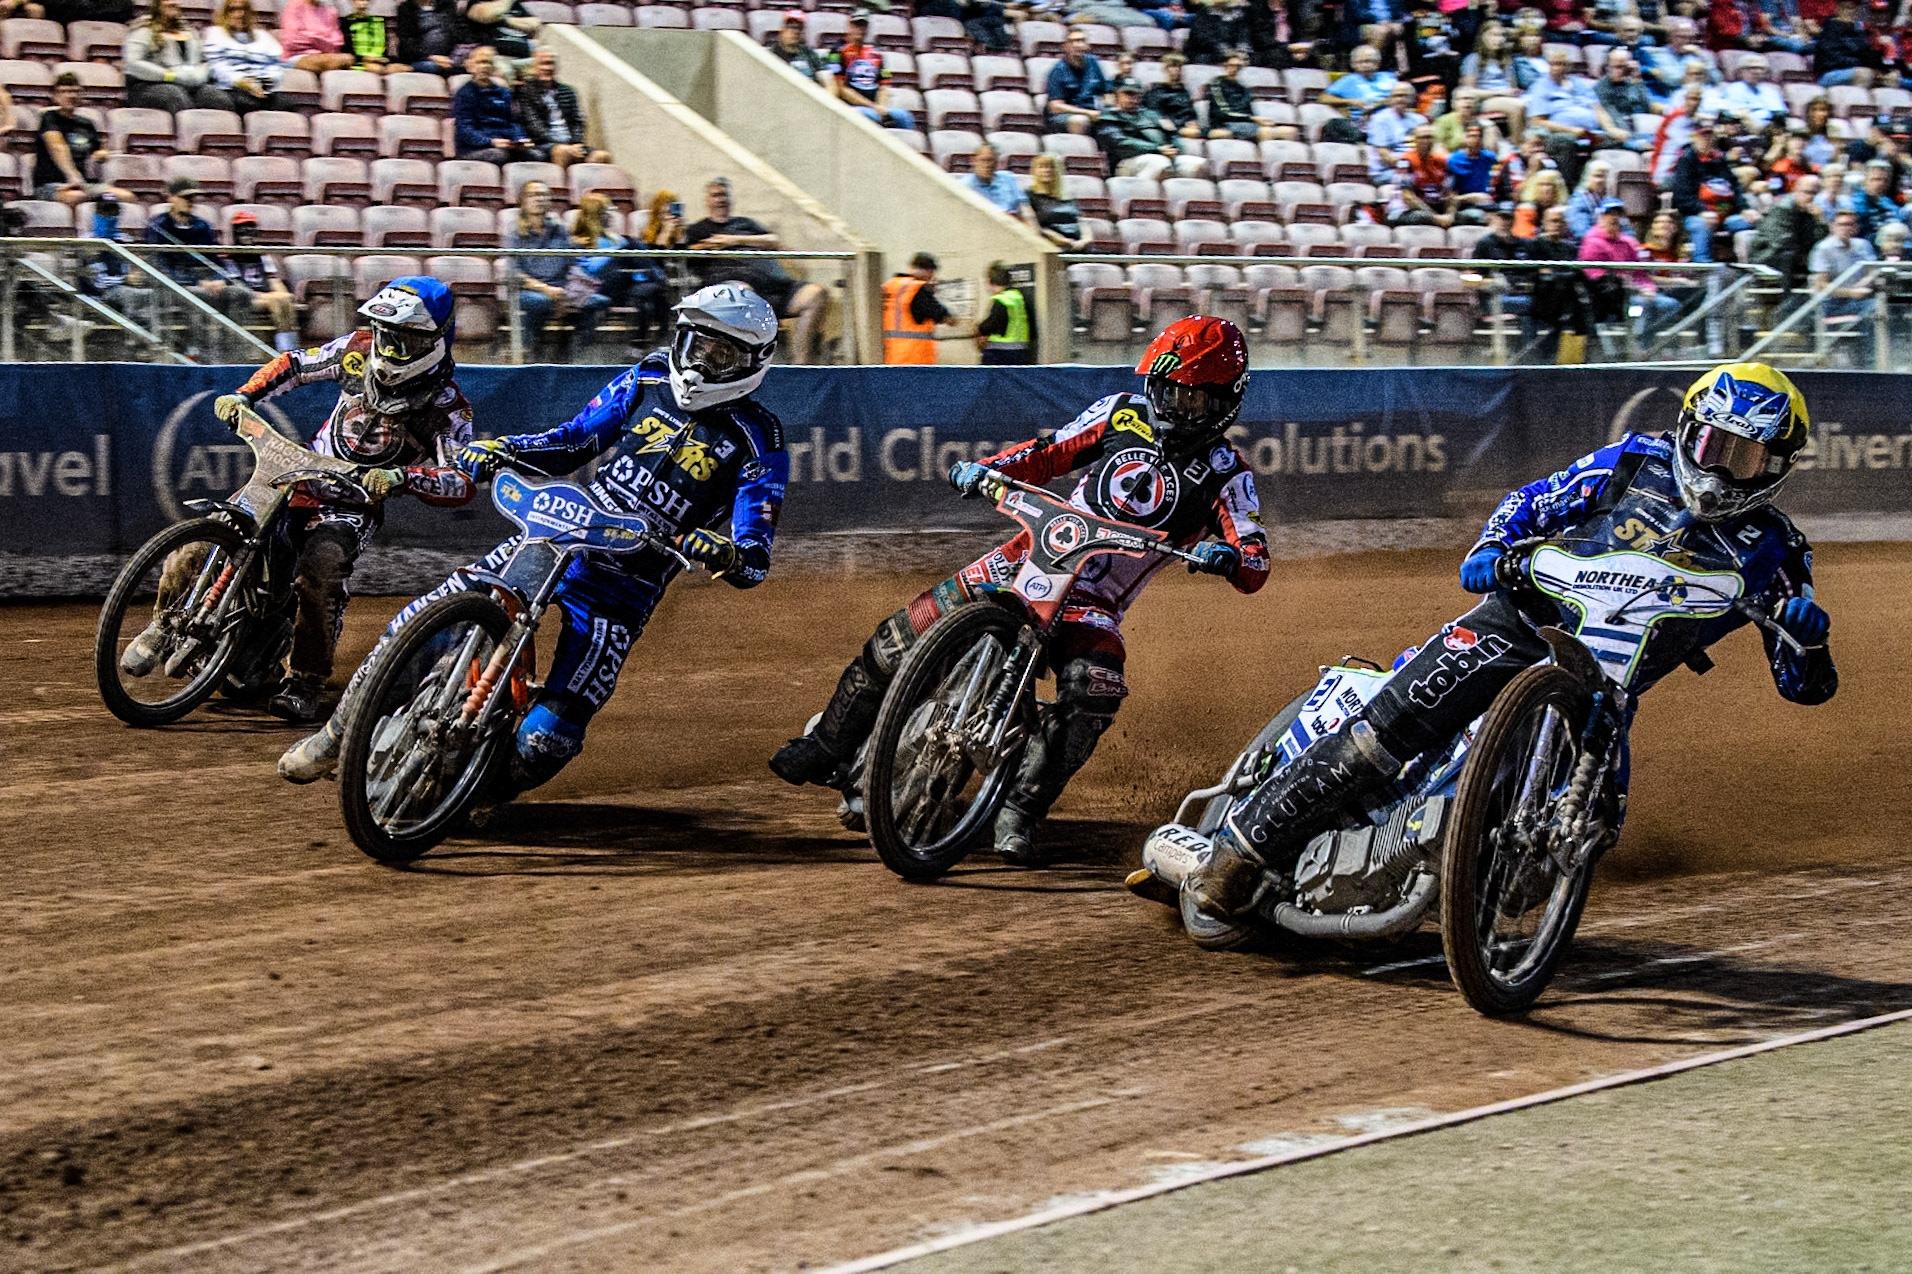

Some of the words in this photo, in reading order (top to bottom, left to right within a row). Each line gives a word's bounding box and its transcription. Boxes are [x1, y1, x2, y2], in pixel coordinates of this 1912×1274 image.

[788, 426, 861, 483] rld
[1115, 452, 1146, 467] BELLE
[1163, 475, 1174, 503] ACES
[547, 495, 596, 528] PSH
[629, 466, 694, 524] PSH
[389, 571, 468, 635] HANSEN
[1408, 634, 1513, 709] tobin
[1250, 761, 1353, 845] GLULAM
